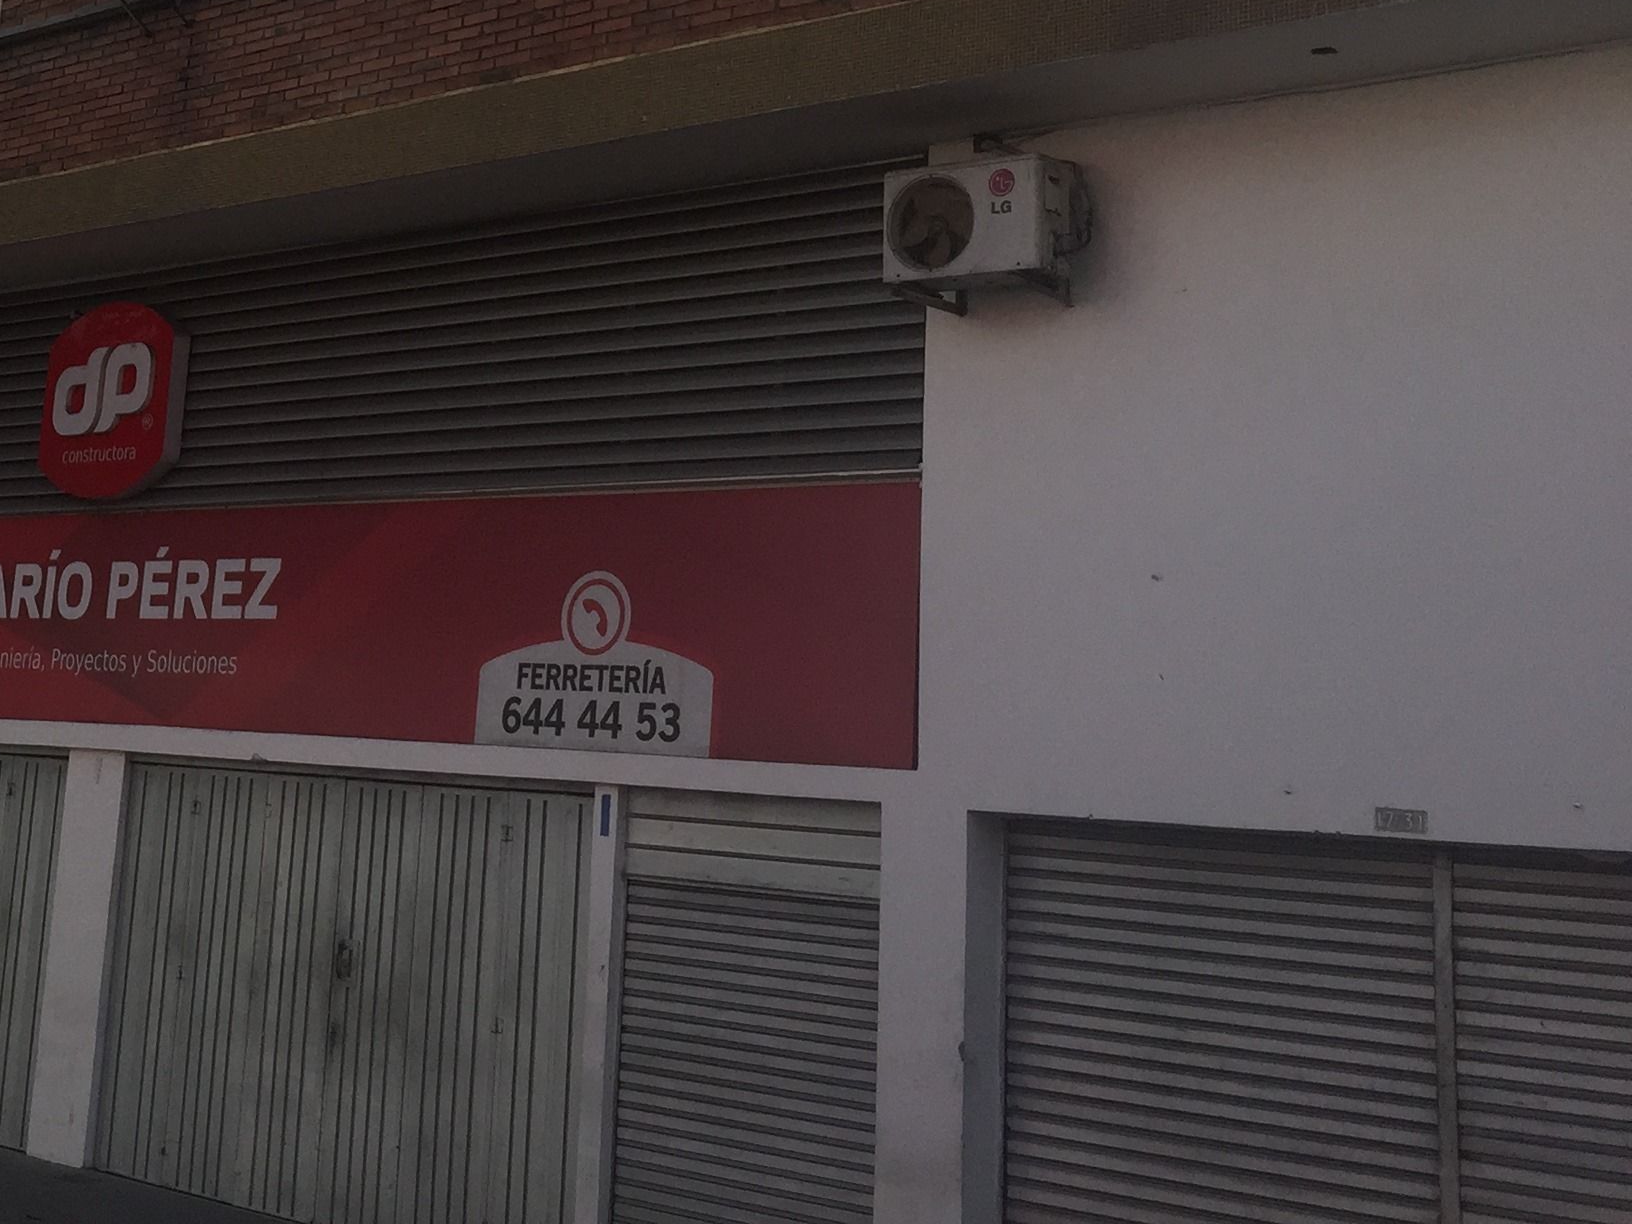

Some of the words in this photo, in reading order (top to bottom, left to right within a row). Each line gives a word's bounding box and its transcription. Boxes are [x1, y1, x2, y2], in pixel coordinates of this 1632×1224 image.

[990, 199, 1012, 214] LG
[62, 444, 137, 464] constructora
[106, 546, 283, 621] PÉREZ
[51, 648, 128, 676] Proyectos
[131, 655, 143, 678] y
[146, 649, 238, 676] Soluciones
[516, 659, 667, 694] FERRETERÍA
[502, 696, 566, 736] 644
[577, 700, 622, 739] 44
[635, 702, 681, 742] 53
